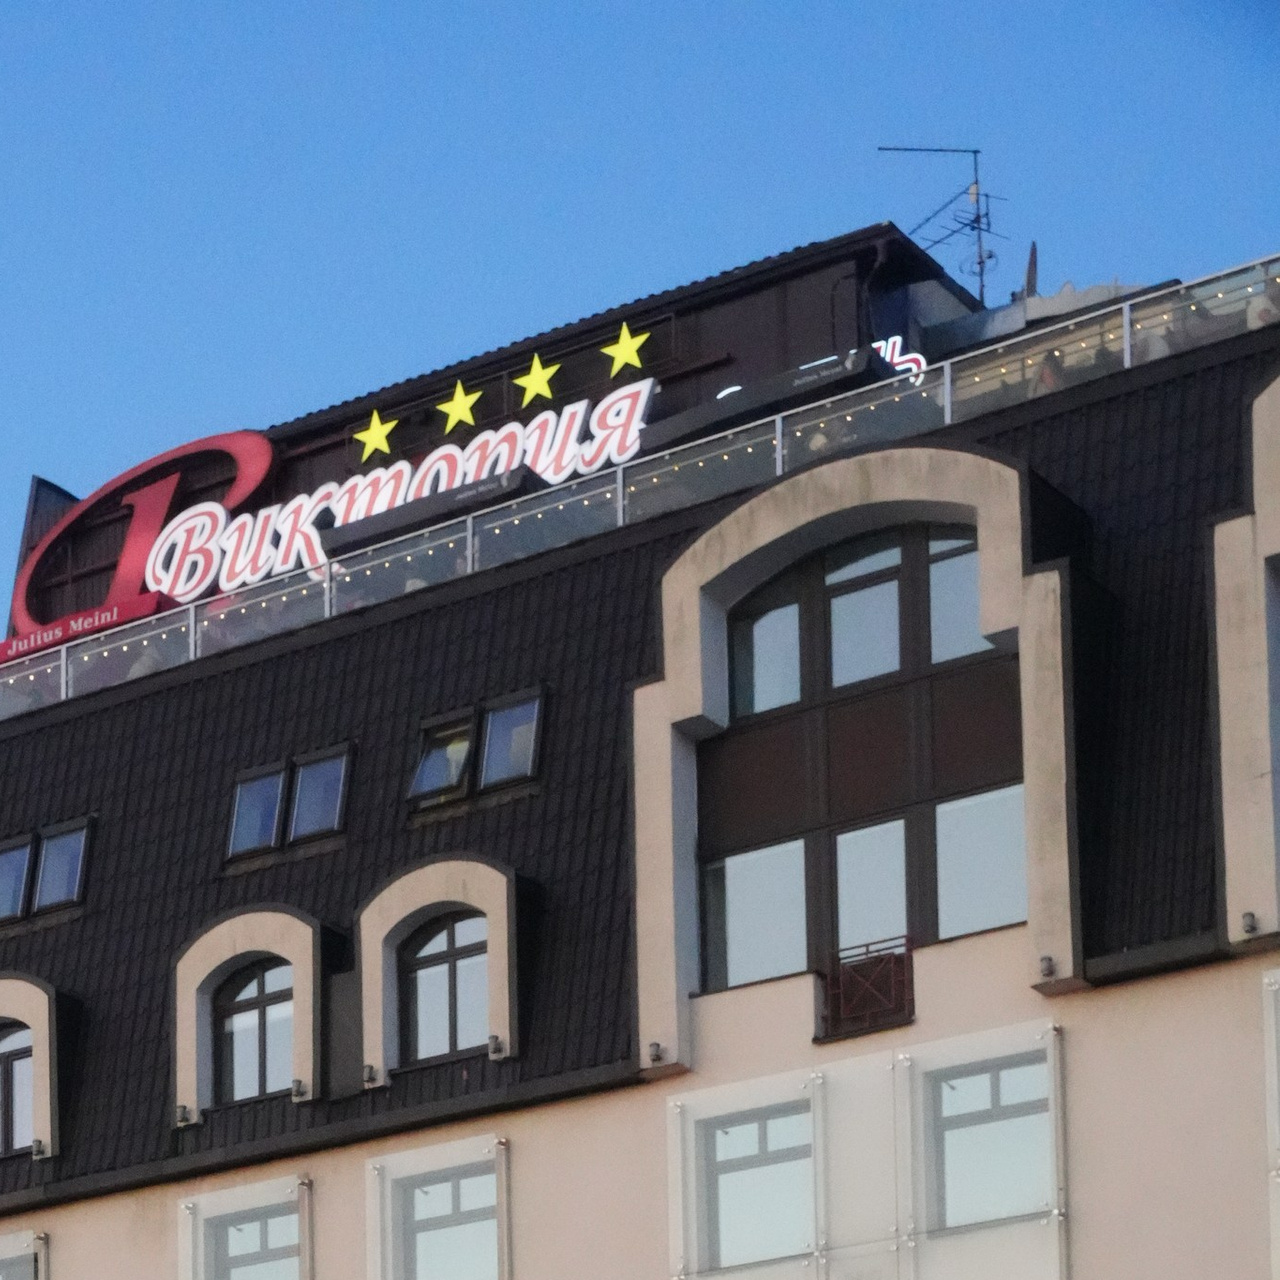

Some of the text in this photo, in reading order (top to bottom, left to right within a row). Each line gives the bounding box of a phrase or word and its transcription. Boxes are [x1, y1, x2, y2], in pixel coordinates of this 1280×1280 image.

[144, 376, 658, 603] Виктория
[7, 606, 119, 656] Julius Meinl
